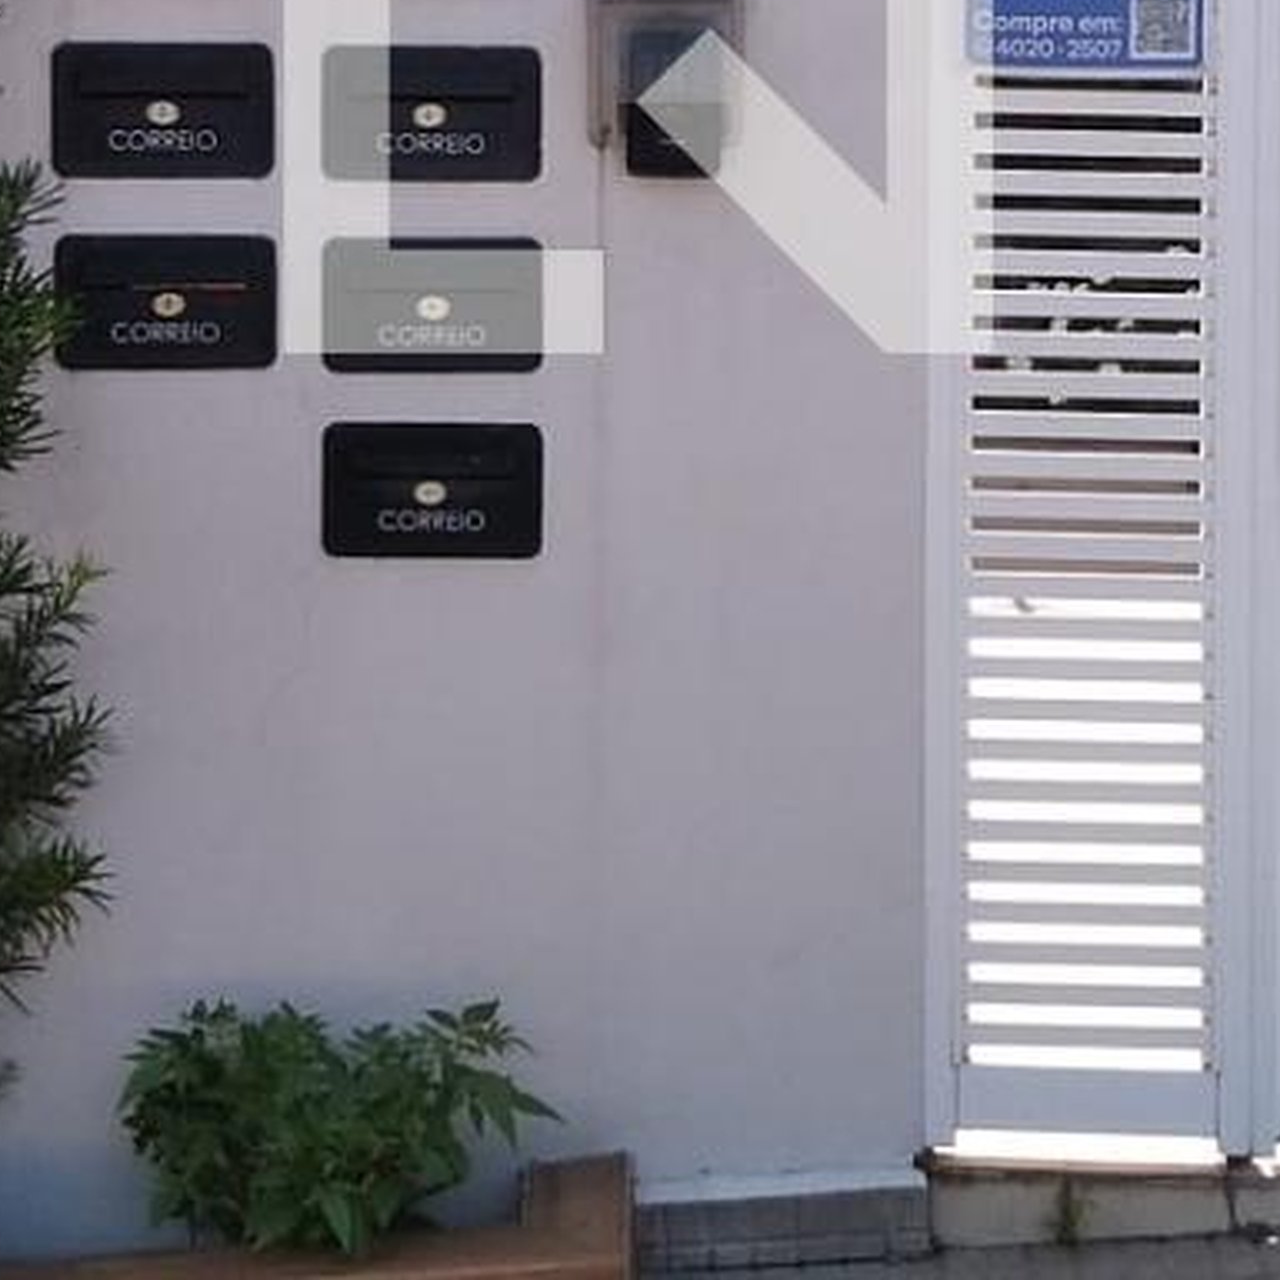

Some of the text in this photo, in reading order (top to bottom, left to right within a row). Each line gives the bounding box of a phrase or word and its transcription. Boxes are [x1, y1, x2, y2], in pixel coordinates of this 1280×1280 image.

[107, 128, 219, 152] CORREIO
[375, 132, 486, 155] CORREIO
[110, 321, 222, 345] CORREIO
[377, 324, 486, 348] CORREIO
[377, 509, 486, 532] CORREIO
